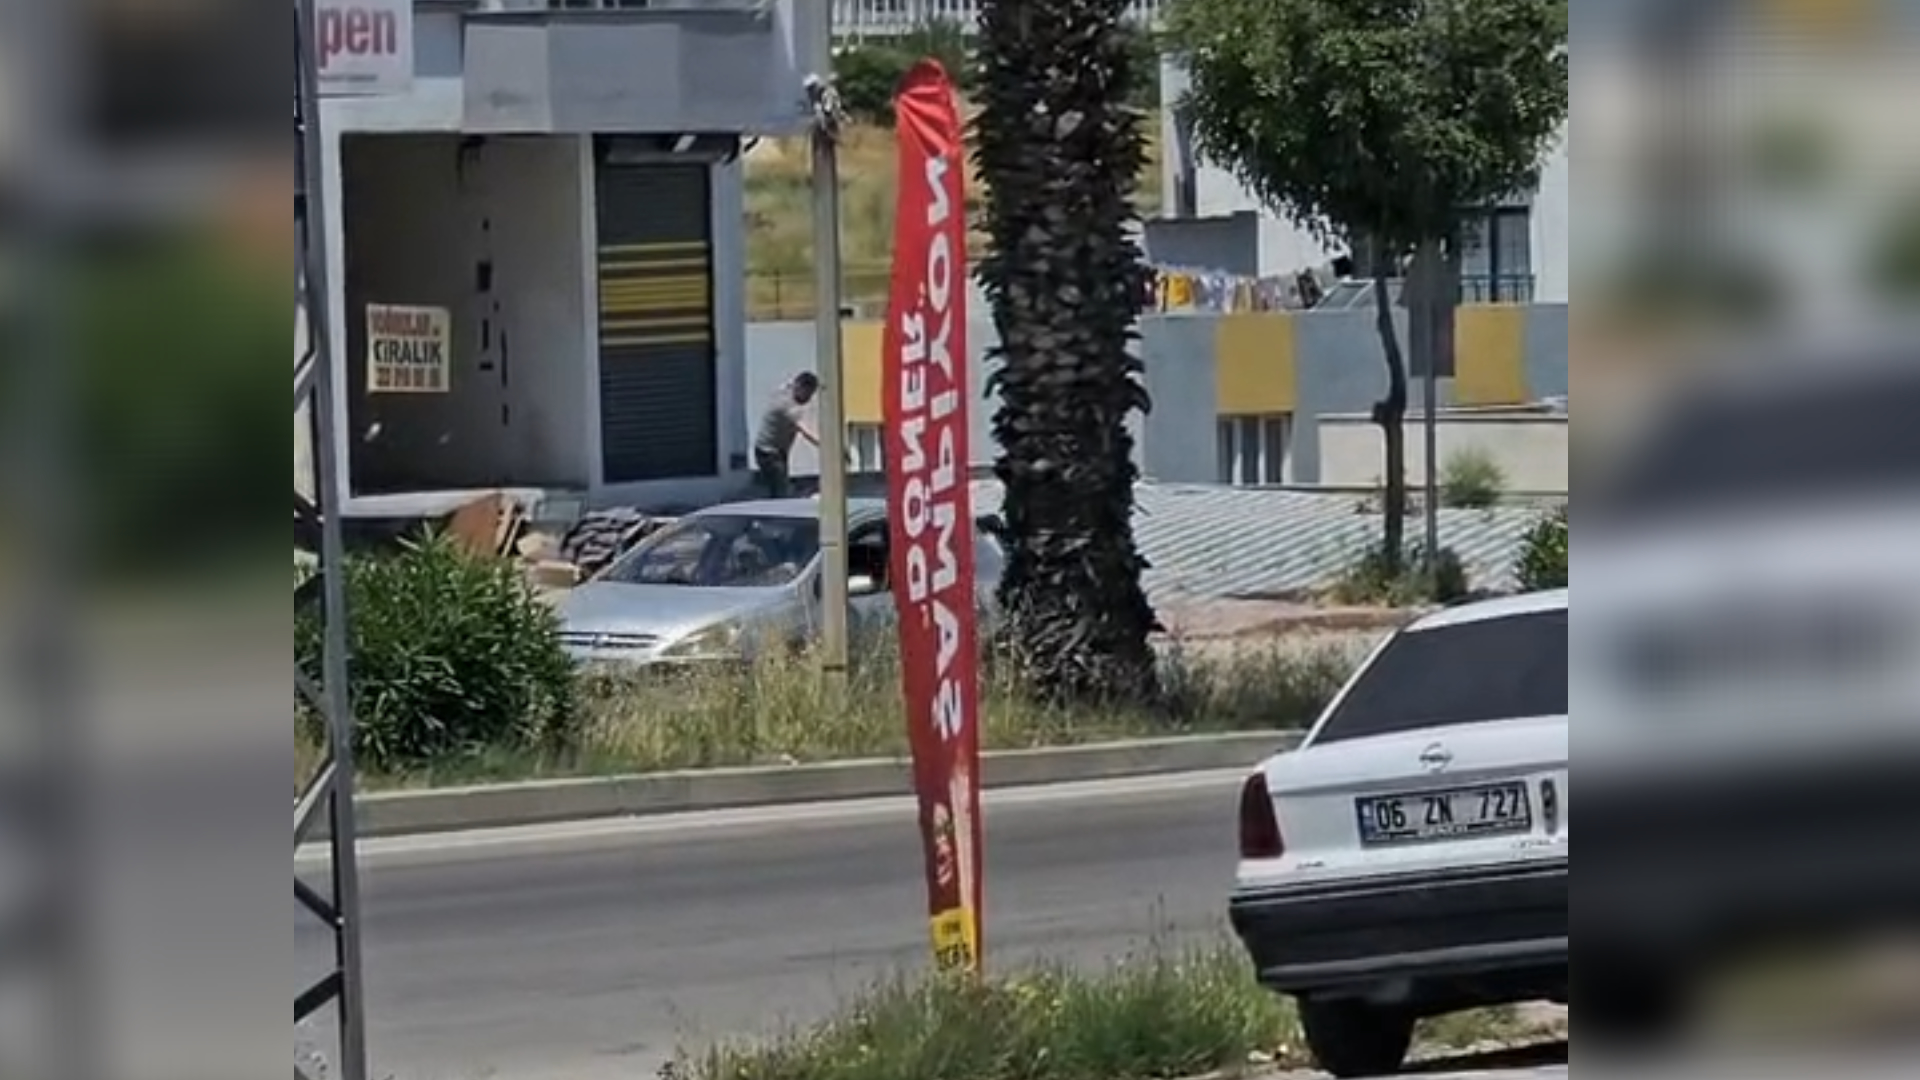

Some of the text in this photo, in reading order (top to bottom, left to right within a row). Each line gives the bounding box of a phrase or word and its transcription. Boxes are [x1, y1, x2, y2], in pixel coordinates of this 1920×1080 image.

[318, 7, 396, 68] pen
[1376, 788, 1519, 831] 06 ZN 727
